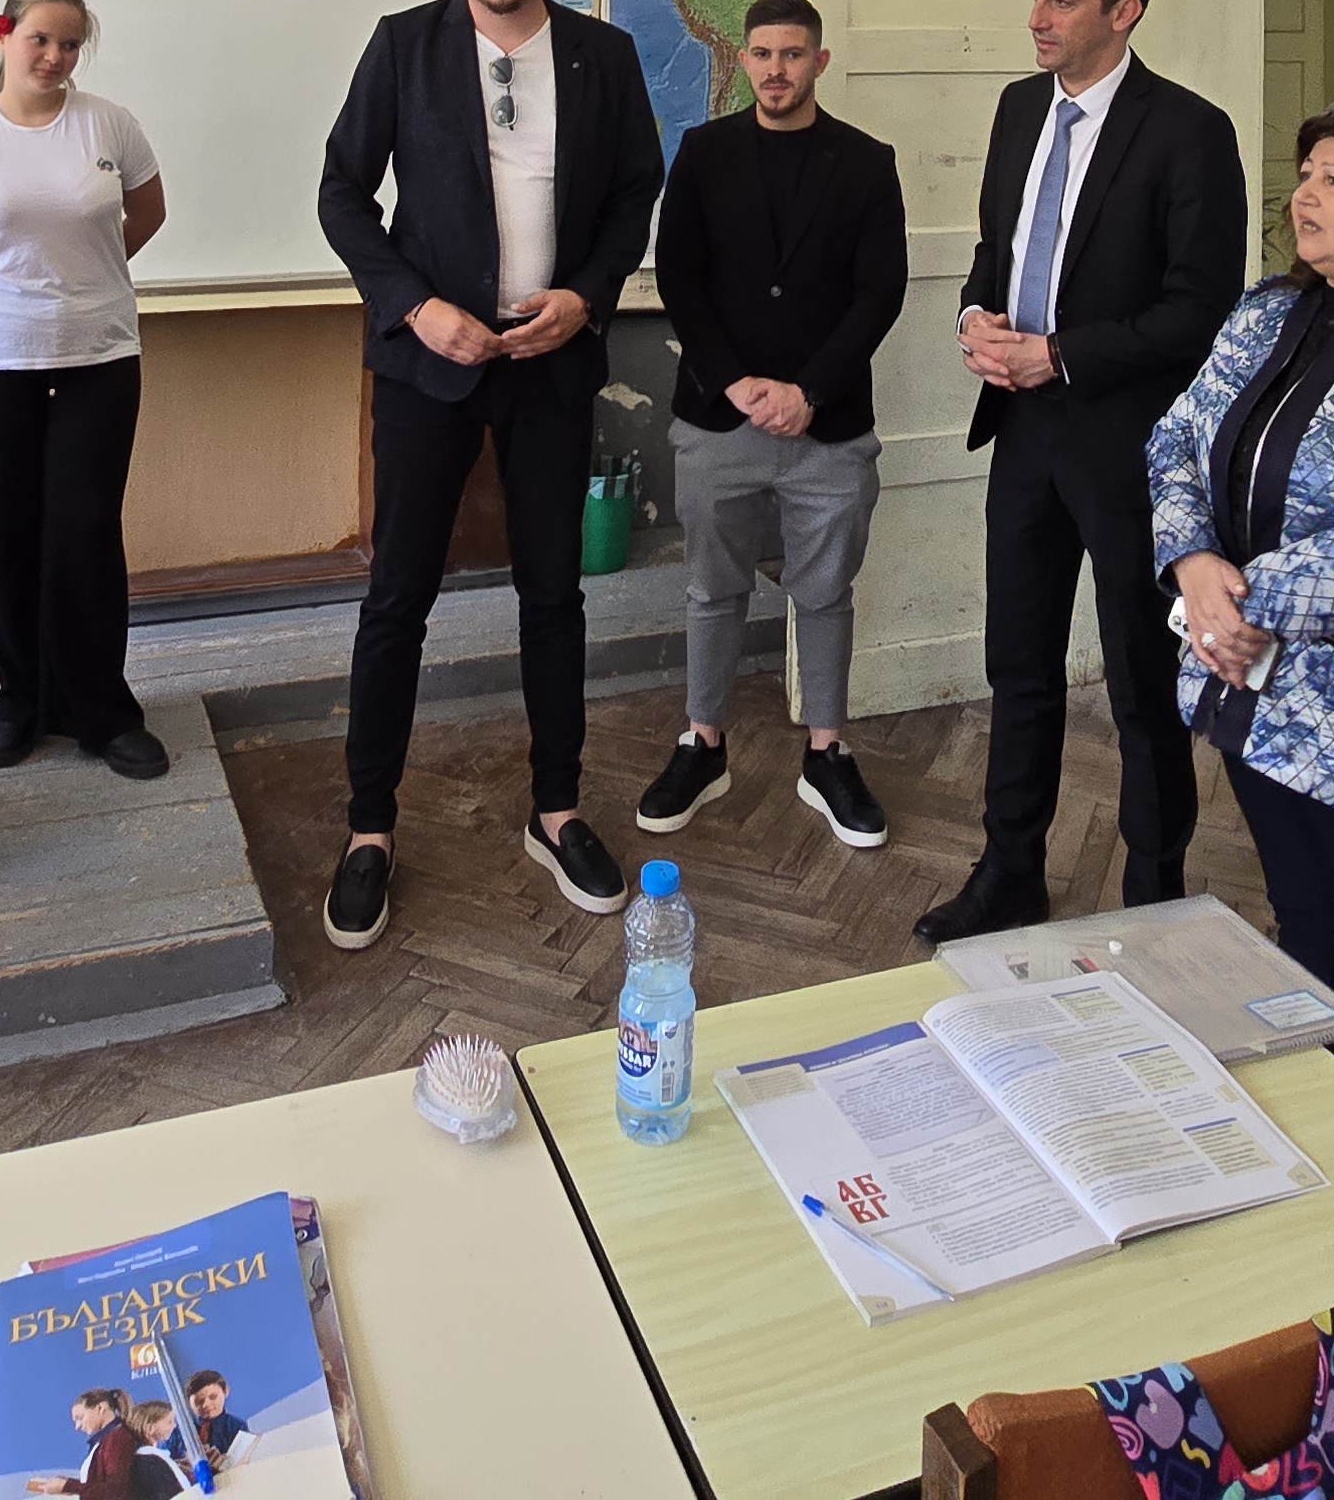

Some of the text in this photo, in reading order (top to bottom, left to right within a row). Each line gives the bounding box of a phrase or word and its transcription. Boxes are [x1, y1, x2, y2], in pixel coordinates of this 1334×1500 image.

[8, 1251, 268, 1344] БЪЛГАРСКИ
[83, 1297, 206, 1353] ЕЗИК
[131, 1365, 158, 1380] кла
